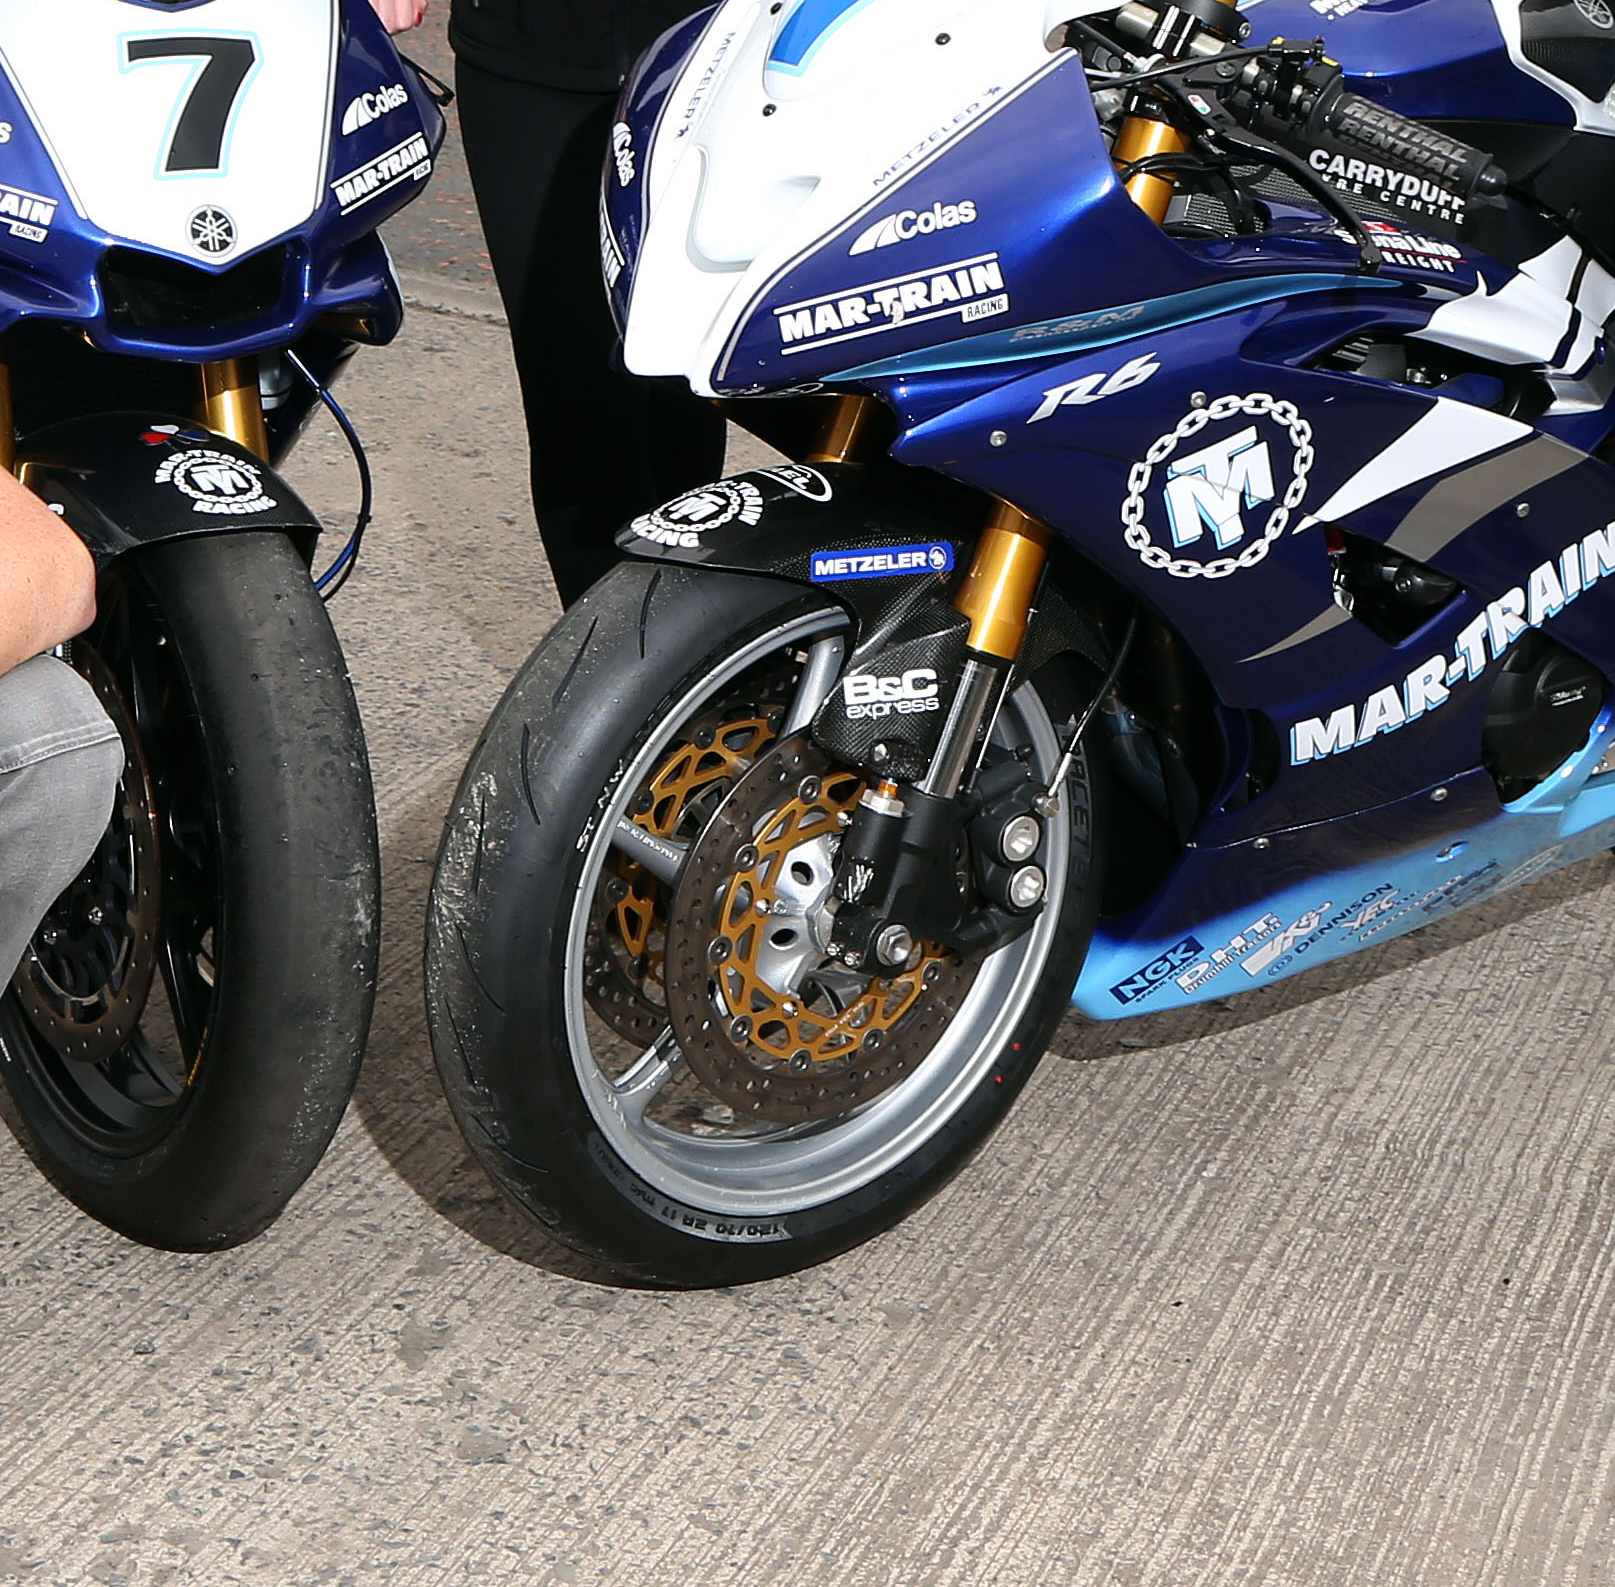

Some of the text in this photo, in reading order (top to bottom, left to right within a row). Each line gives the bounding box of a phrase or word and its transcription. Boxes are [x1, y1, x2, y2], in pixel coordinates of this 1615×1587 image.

[683, 31, 736, 119] METZELER
[126, 35, 256, 172] 7
[361, 84, 408, 119] Colas
[872, 102, 982, 187] METZELER
[1338, 115, 1461, 182] RENTHAL
[1343, 100, 1468, 164] RENTHAL
[335, 137, 429, 207] MAR-TRAIN
[895, 200, 978, 241] Colas
[1379, 190, 1465, 225] CENTRE
[1380, 250, 1456, 273] REIGHT
[779, 261, 1005, 344] MAR-TRAIN
[967, 298, 1004, 320] RACING
[192, 495, 278, 514] RACING
[815, 551, 927, 576] METZELER
[843, 668, 938, 706] B&C
[846, 697, 940, 720] express
[1295, 883, 1393, 954] DENNISON
[1121, 941, 1202, 1001] NGK
